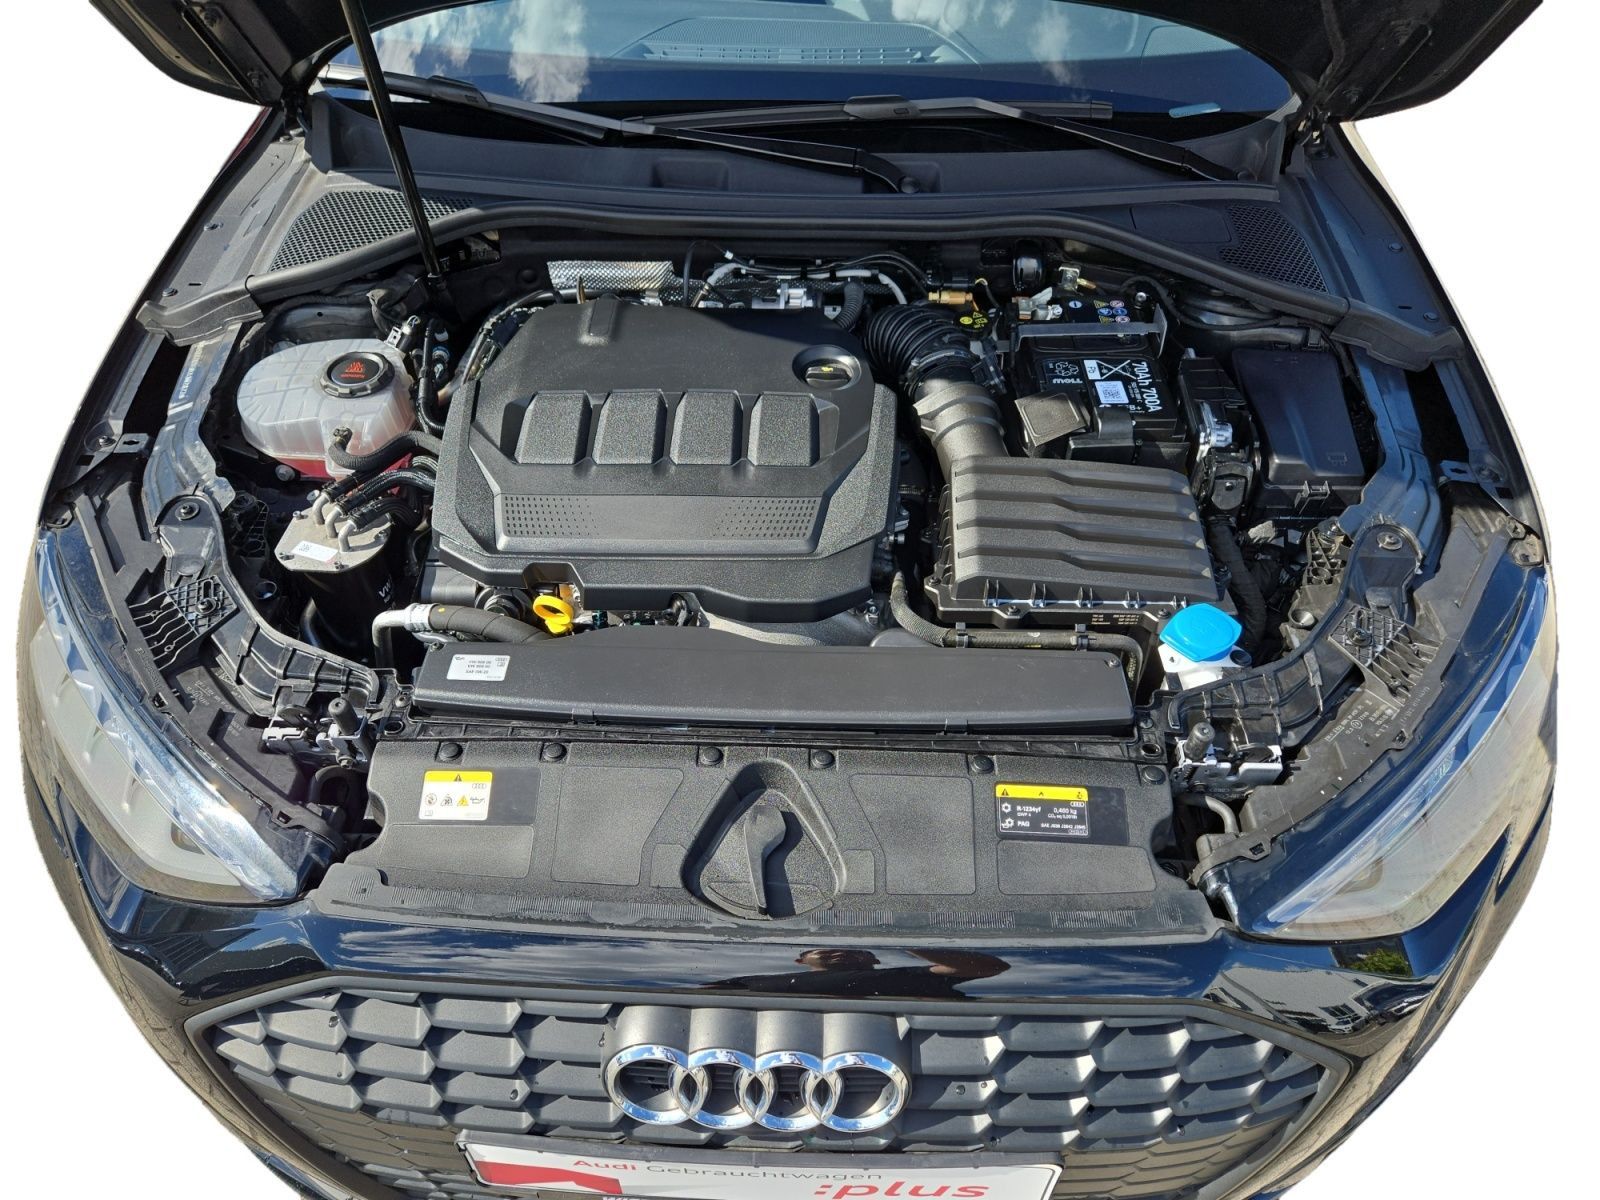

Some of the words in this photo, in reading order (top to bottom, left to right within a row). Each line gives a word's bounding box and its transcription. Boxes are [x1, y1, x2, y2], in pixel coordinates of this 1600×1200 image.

[1087, 366, 1097, 374] Pb
[1132, 361, 1153, 386] 70Ah
[1141, 388, 1163, 412] 700A
[574, 1159, 637, 1171] Audi
[646, 1165, 882, 1180] Gebrauchtwagen
[814, 1181, 990, 1200] :plus
